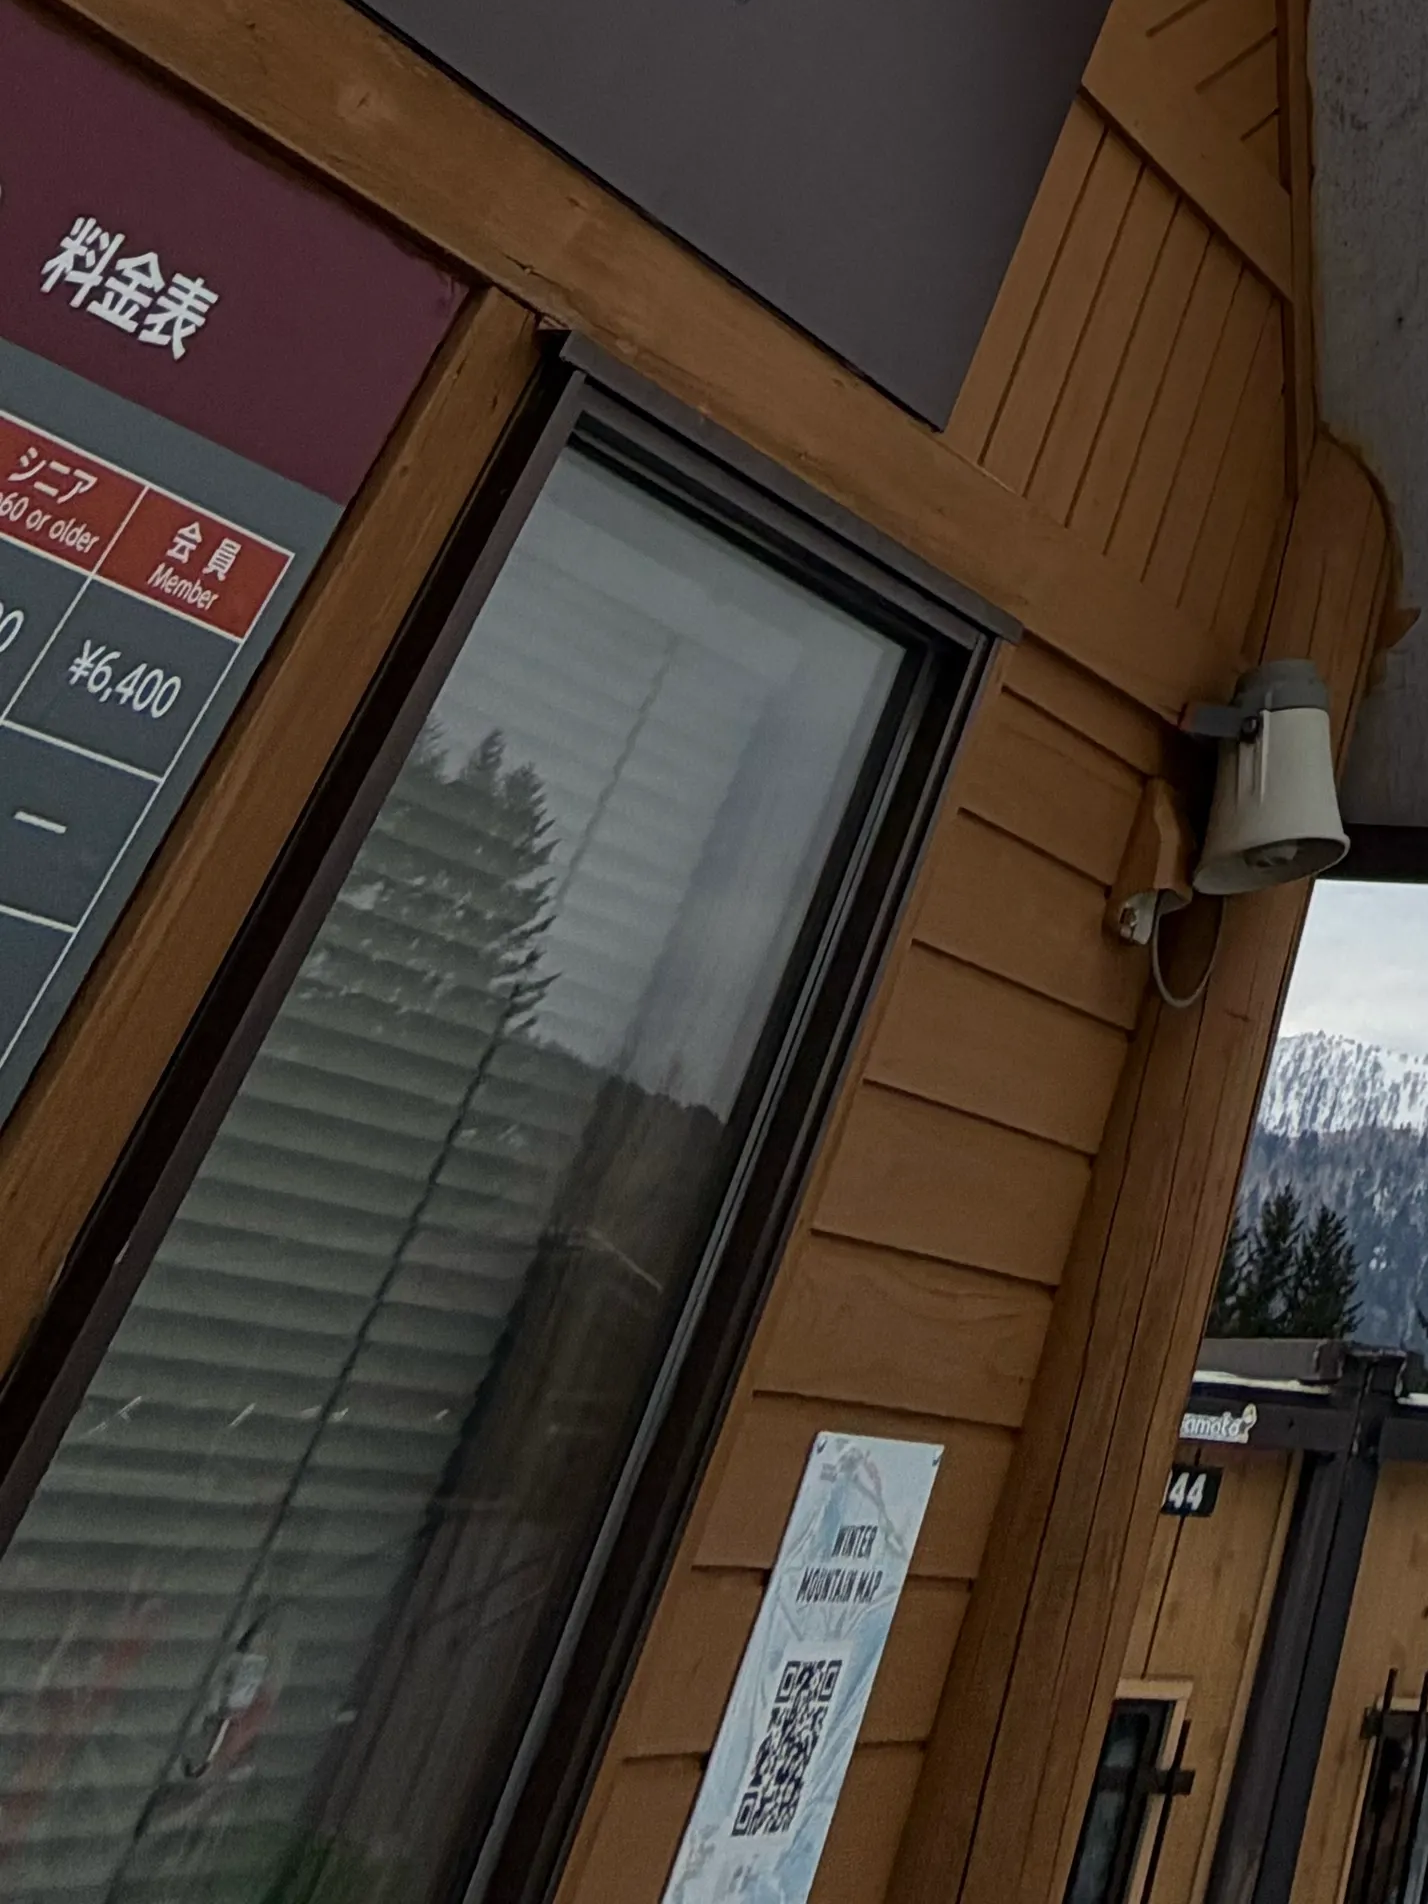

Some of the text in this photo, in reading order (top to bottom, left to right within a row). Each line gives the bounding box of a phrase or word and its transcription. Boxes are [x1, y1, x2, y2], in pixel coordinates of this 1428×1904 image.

[40, 216, 219, 361] 料金表
[8, 446, 98, 505] シニア
[26, 509, 51, 531] or
[49, 518, 100, 553] older
[166, 521, 242, 582] 会員
[147, 562, 220, 611] Member
[68, 639, 182, 719] ¥6,400
[1161, 1470, 1207, 1511] 44
[831, 1525, 879, 1560] WINTER
[796, 1566, 884, 1604] MOUNTAIN MAP
